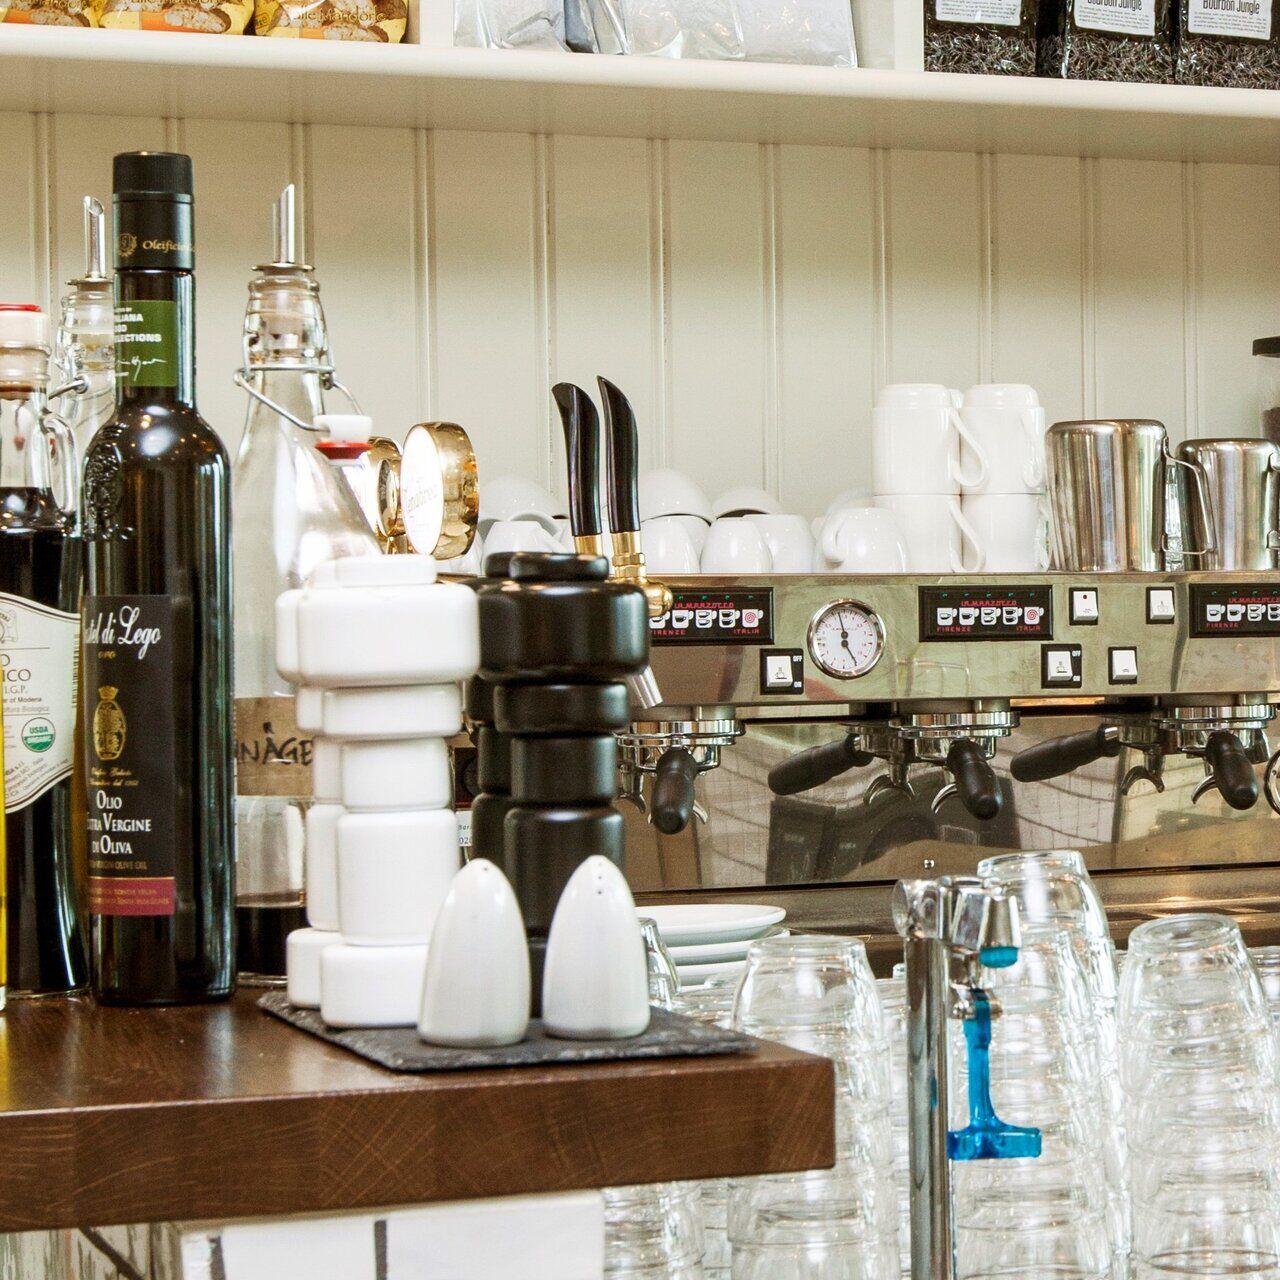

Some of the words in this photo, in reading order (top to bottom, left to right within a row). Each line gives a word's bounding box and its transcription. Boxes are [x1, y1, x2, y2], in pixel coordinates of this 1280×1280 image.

[101, 613, 115, 642] di
[118, 605, 161, 660] Lego
[29, 725, 48, 735] USDA
